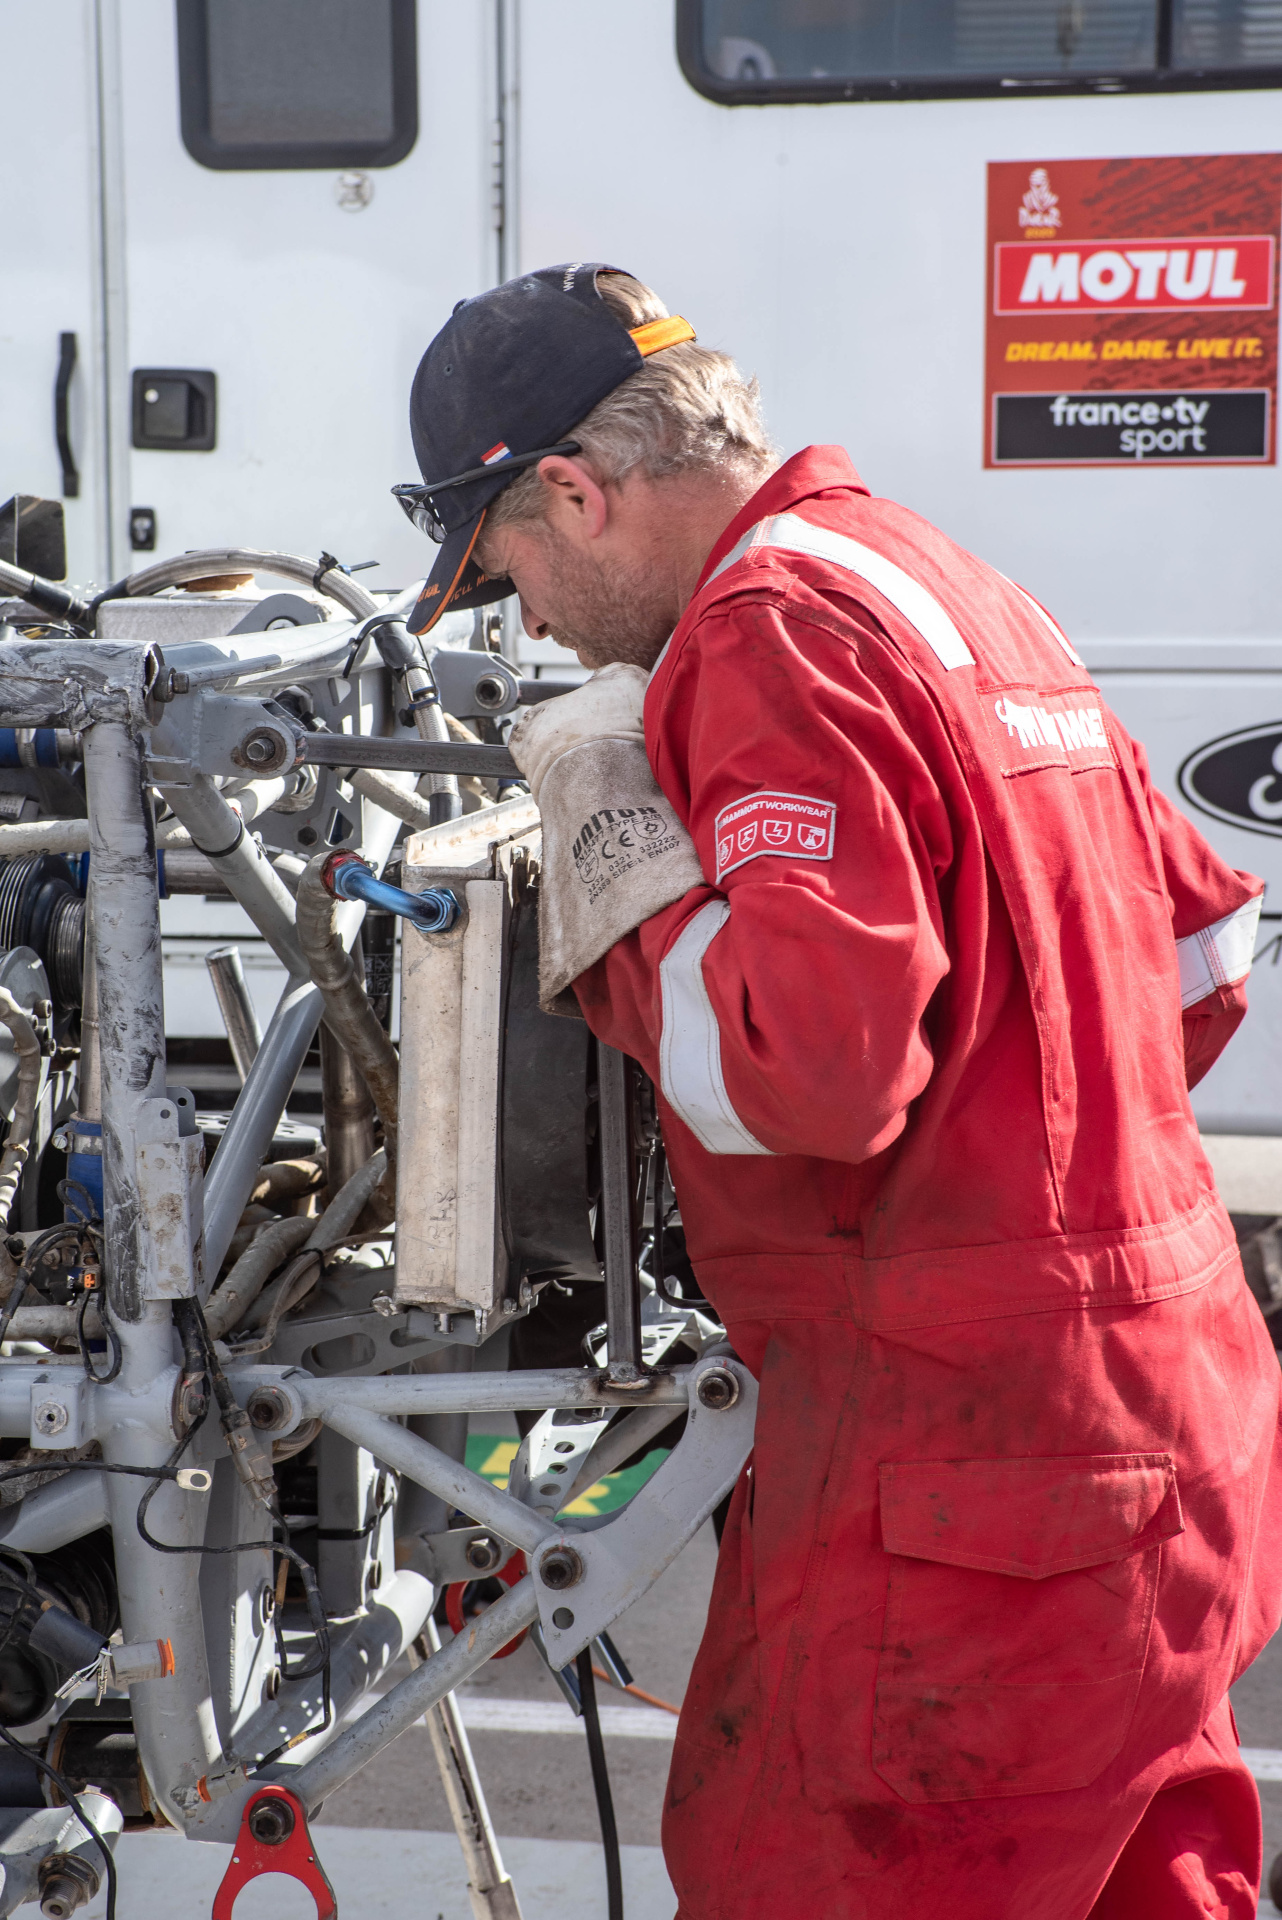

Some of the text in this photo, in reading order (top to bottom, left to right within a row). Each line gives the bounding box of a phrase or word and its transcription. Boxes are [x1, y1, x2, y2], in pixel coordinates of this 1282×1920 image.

[1018, 249, 1247, 303] MOTUL
[1005, 337, 1264, 362] DREAM. DARE. LIVE IT.
[1119, 425, 1207, 461] sport
[572, 807, 657, 859] UNITOR
[607, 817, 639, 832] TYPE
[608, 853, 632, 872] 0321
[639, 835, 677, 854] 332222
[647, 840, 680, 859] EN407
